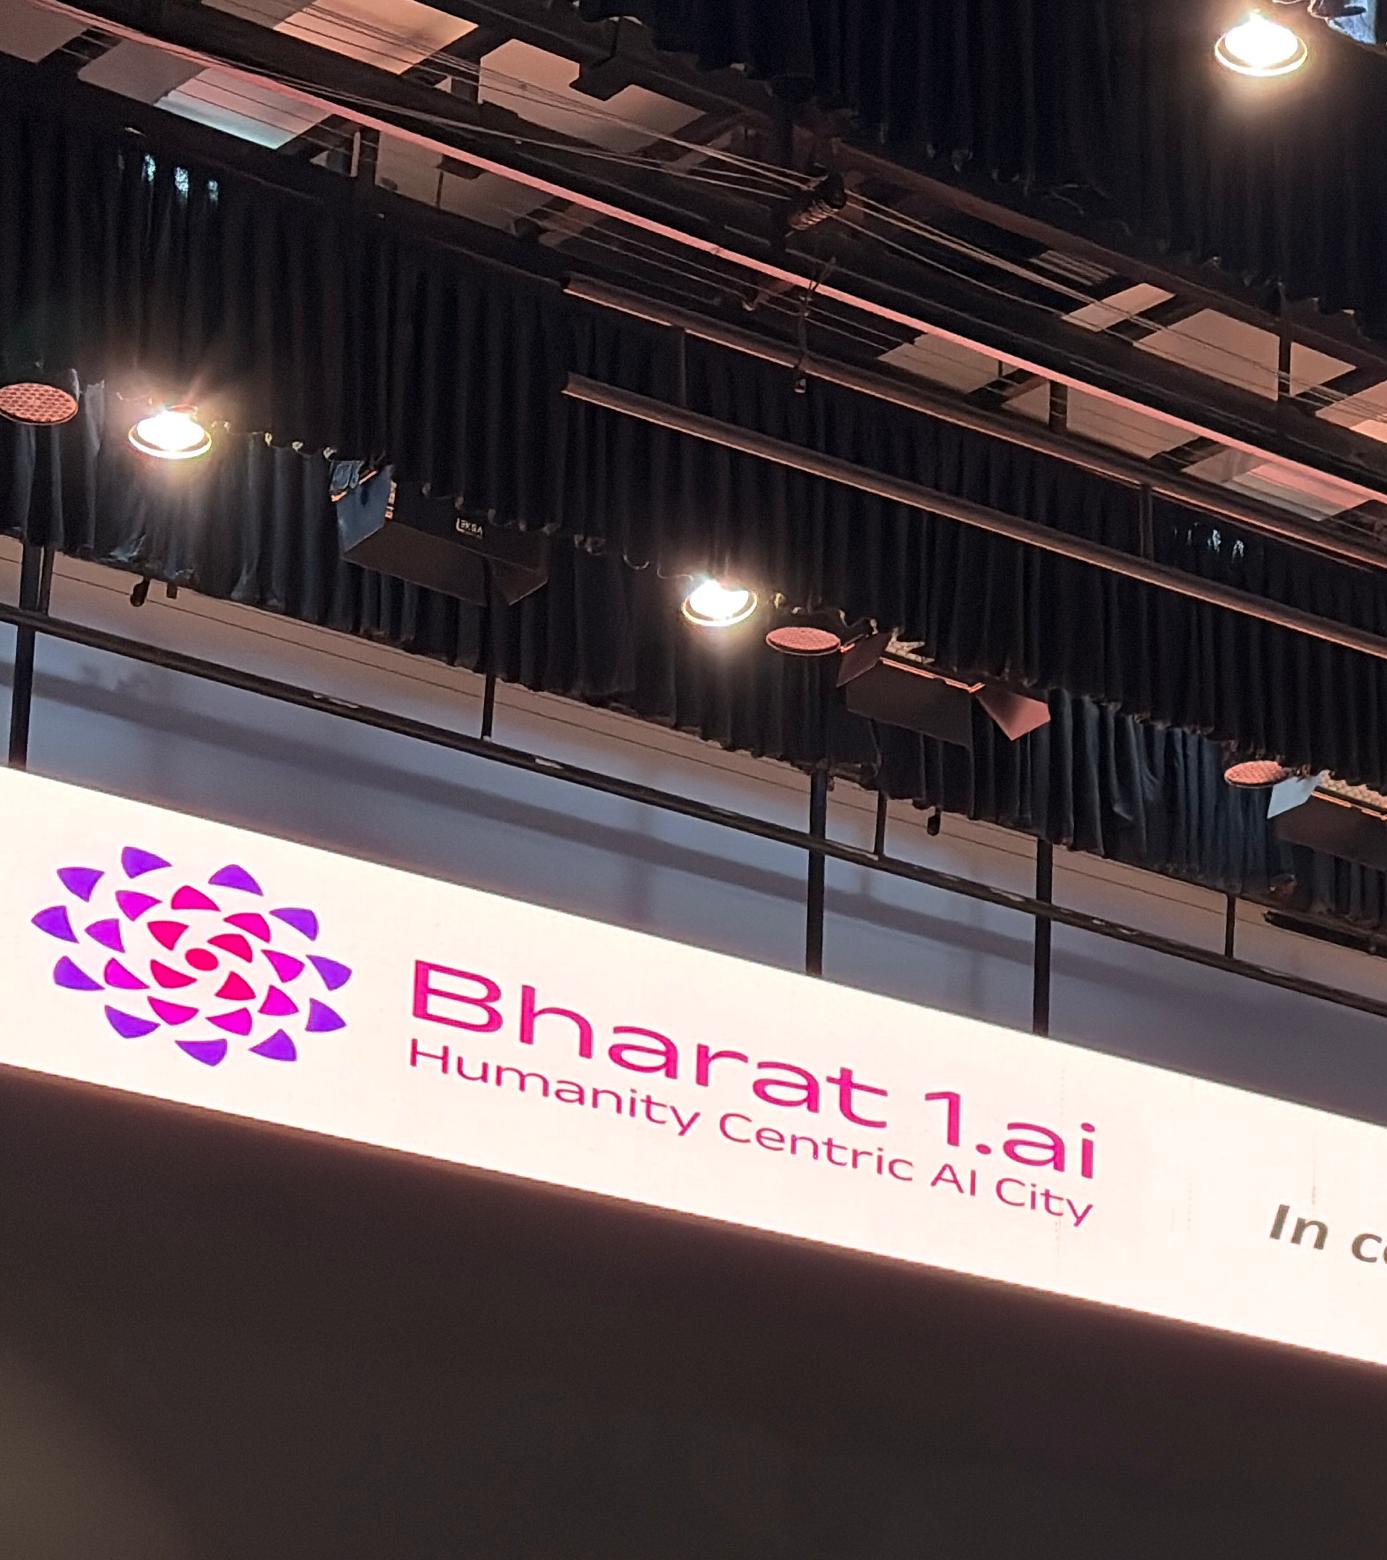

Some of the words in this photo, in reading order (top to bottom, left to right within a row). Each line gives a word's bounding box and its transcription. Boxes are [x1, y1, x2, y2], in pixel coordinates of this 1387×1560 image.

[409, 1037, 702, 1138] Humanity
[719, 1112, 914, 1182] Centric
[930, 1163, 978, 1198] AI
[995, 1177, 1095, 1229] City
[411, 959, 889, 1129] Bharat
[924, 1090, 1096, 1180] 1.ai
[1269, 1204, 1329, 1251] In
